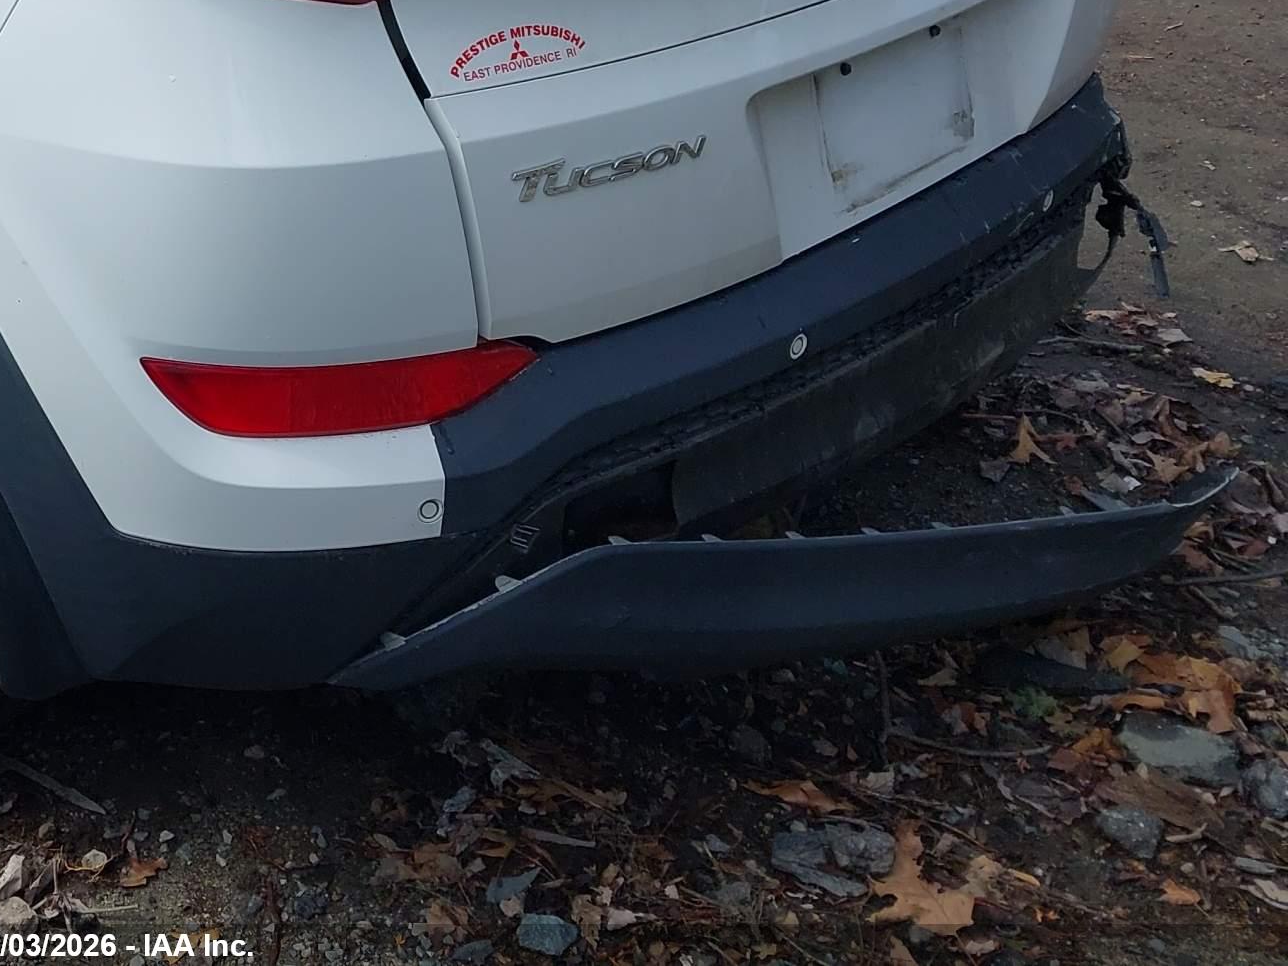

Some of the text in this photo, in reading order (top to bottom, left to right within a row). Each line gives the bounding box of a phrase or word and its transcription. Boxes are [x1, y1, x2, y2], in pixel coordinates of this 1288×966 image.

[450, 24, 586, 78] PRESTIGE MITSUBISHI
[463, 47, 577, 82] EAST PROVIDENCE RI
[511, 134, 707, 203] TUCSON
